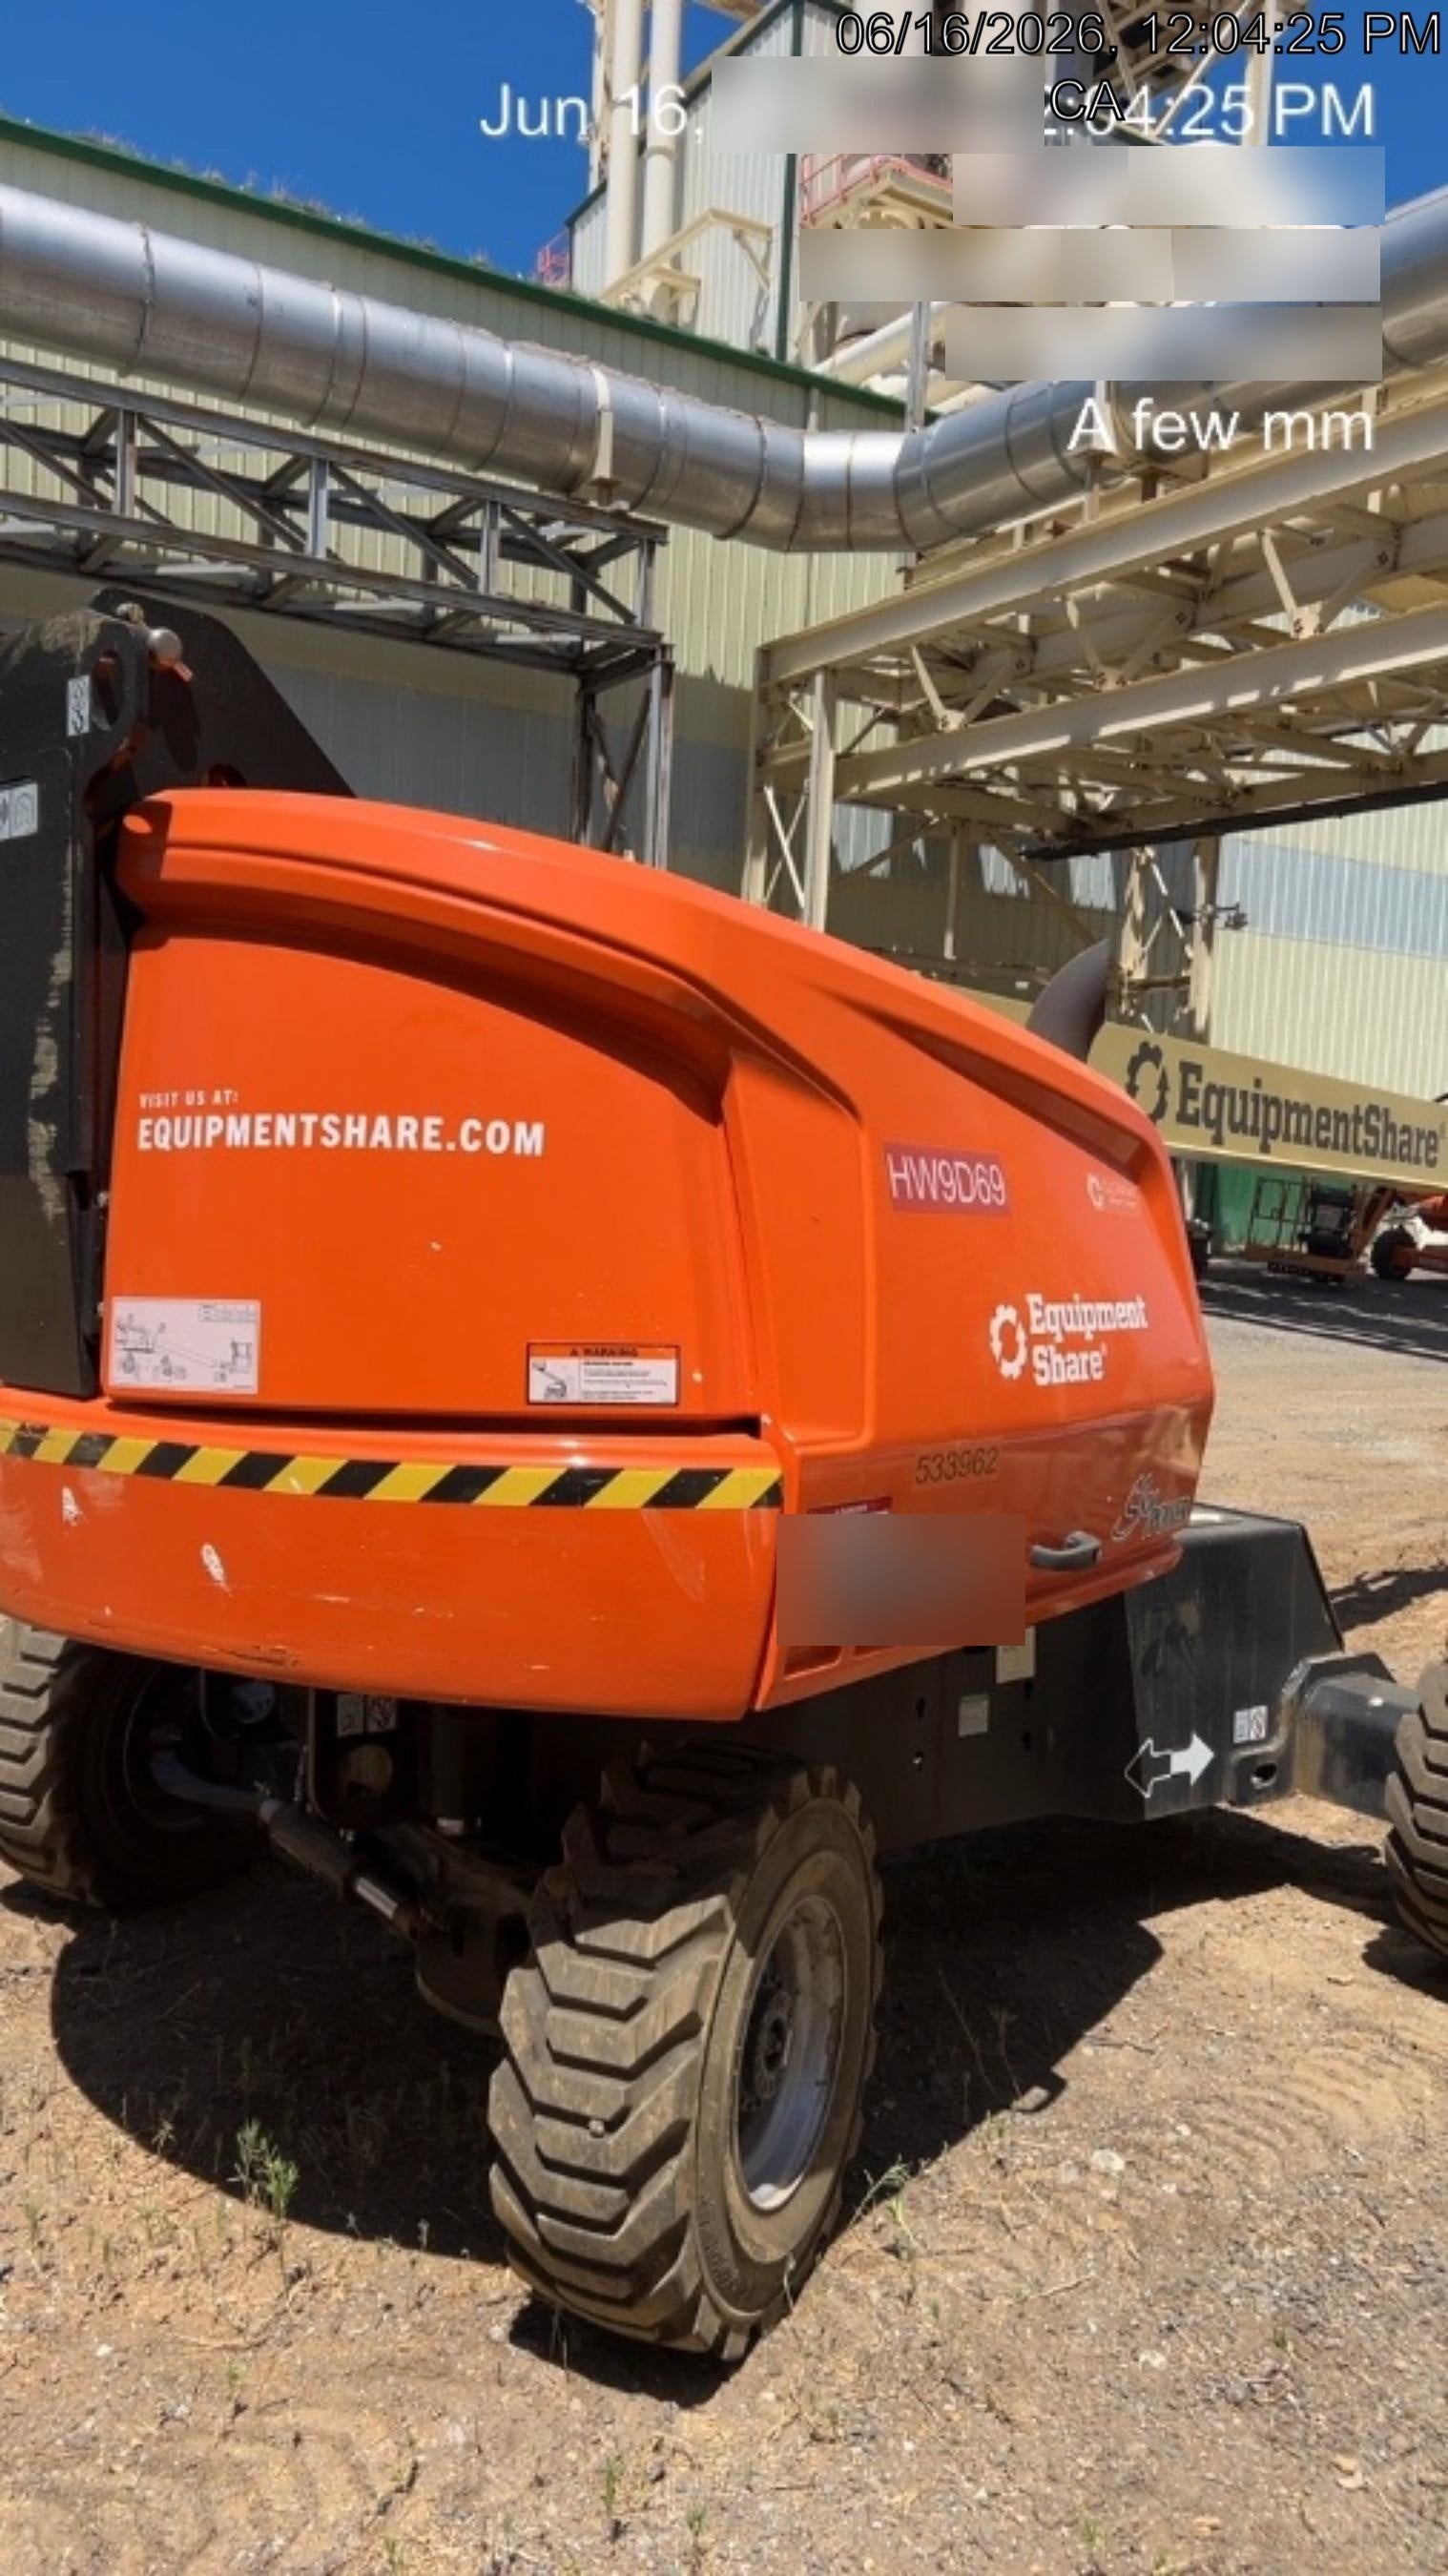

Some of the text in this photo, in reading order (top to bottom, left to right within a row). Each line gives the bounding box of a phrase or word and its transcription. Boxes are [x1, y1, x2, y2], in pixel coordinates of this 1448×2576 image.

[138, 1089, 238, 1109] VISIT US AT:
[137, 1113, 545, 1156] EQUIPMENTSHARE.COM
[886, 1153, 1005, 1206] HW9D69
[1025, 1293, 1148, 1342] Equipment
[916, 1445, 1000, 1485] 533962
